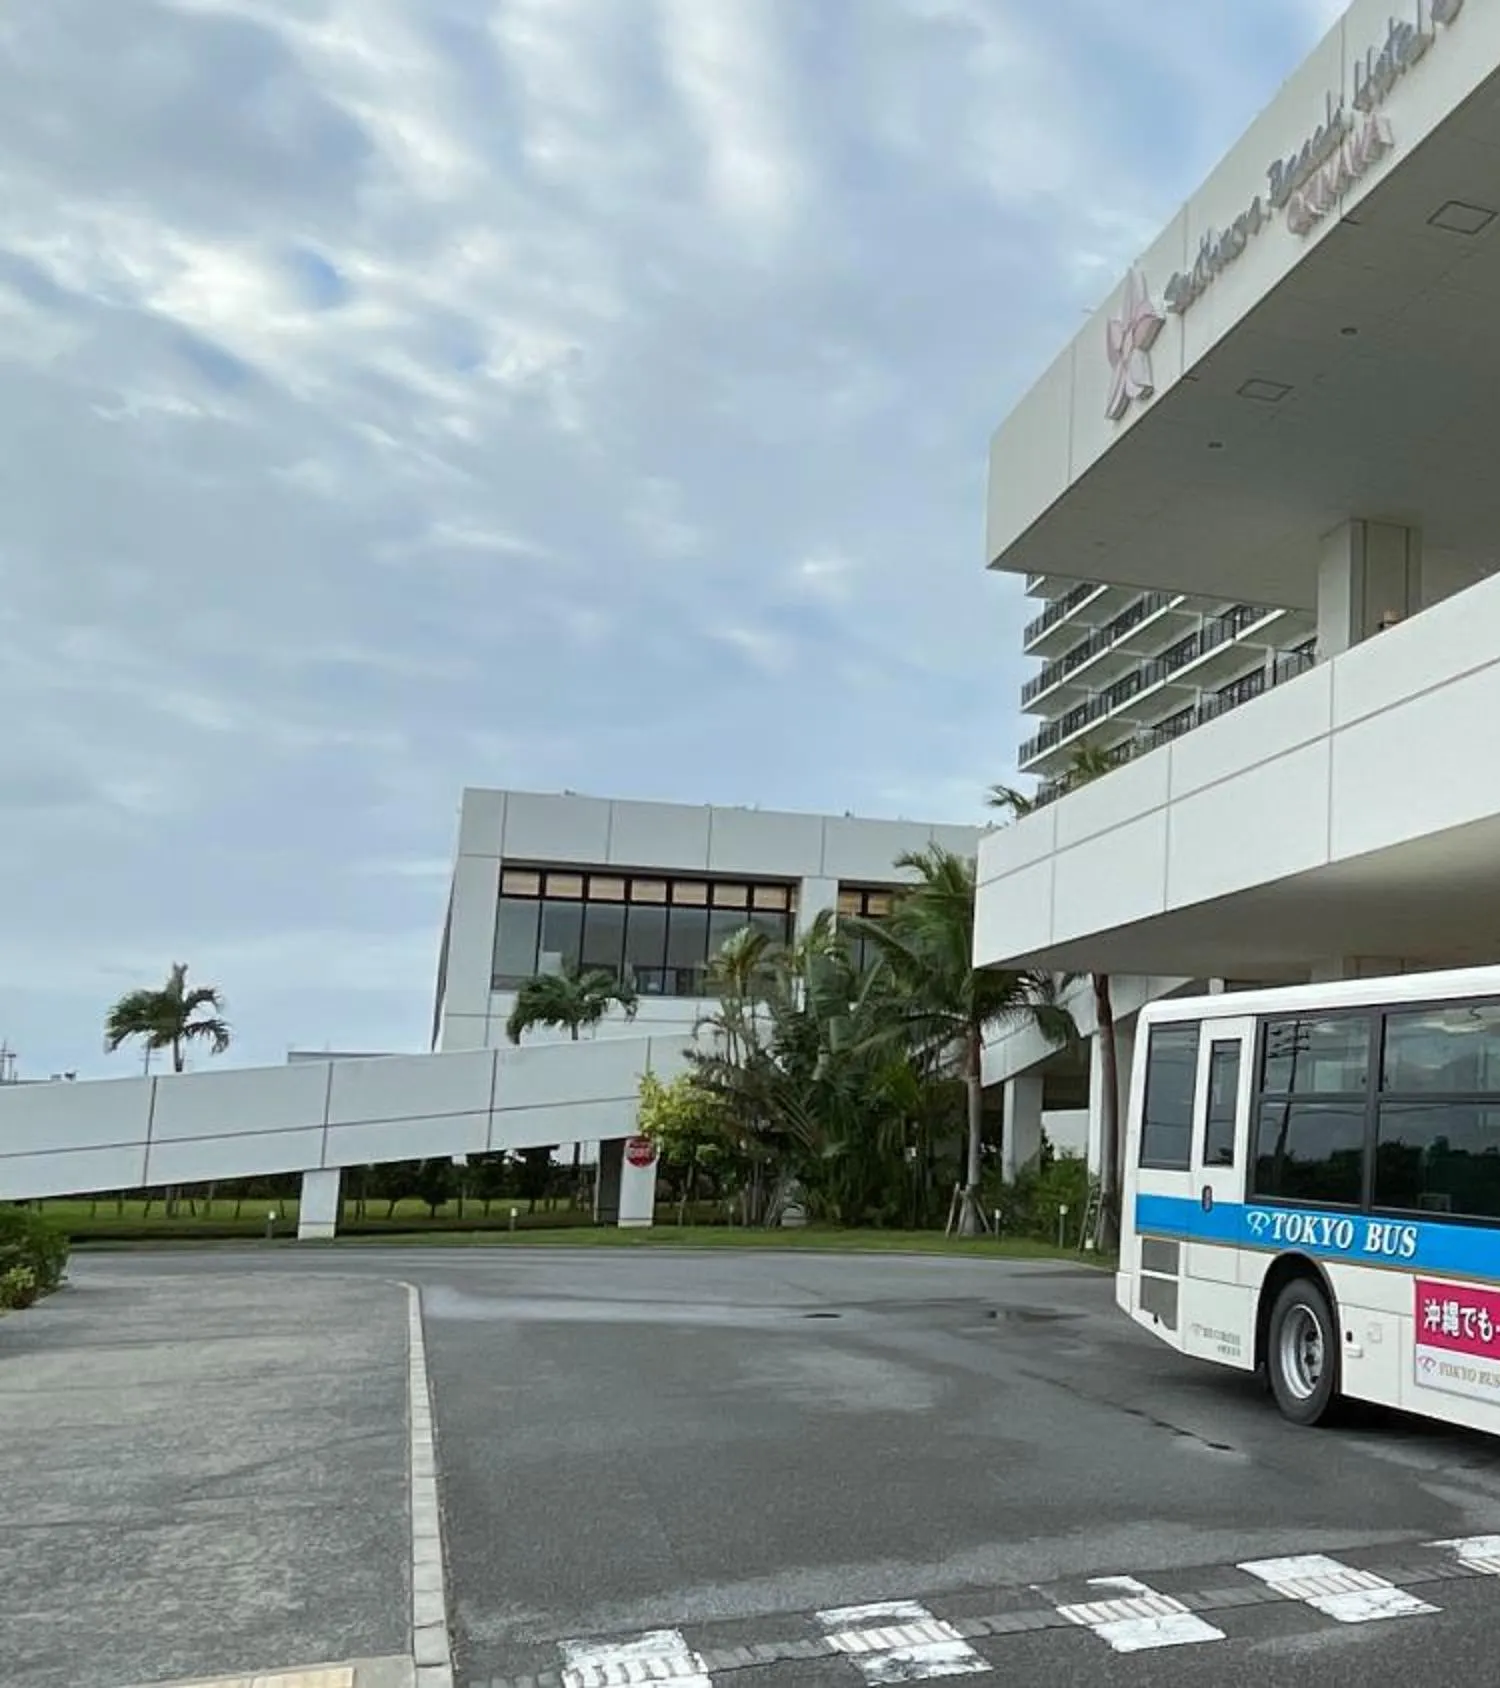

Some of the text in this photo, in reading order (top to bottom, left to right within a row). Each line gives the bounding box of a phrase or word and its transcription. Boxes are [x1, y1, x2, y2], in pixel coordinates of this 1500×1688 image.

[1271, 1213, 1418, 1258] TOKYO BUS
[1439, 1362, 1500, 1388] TOKYO BUS
